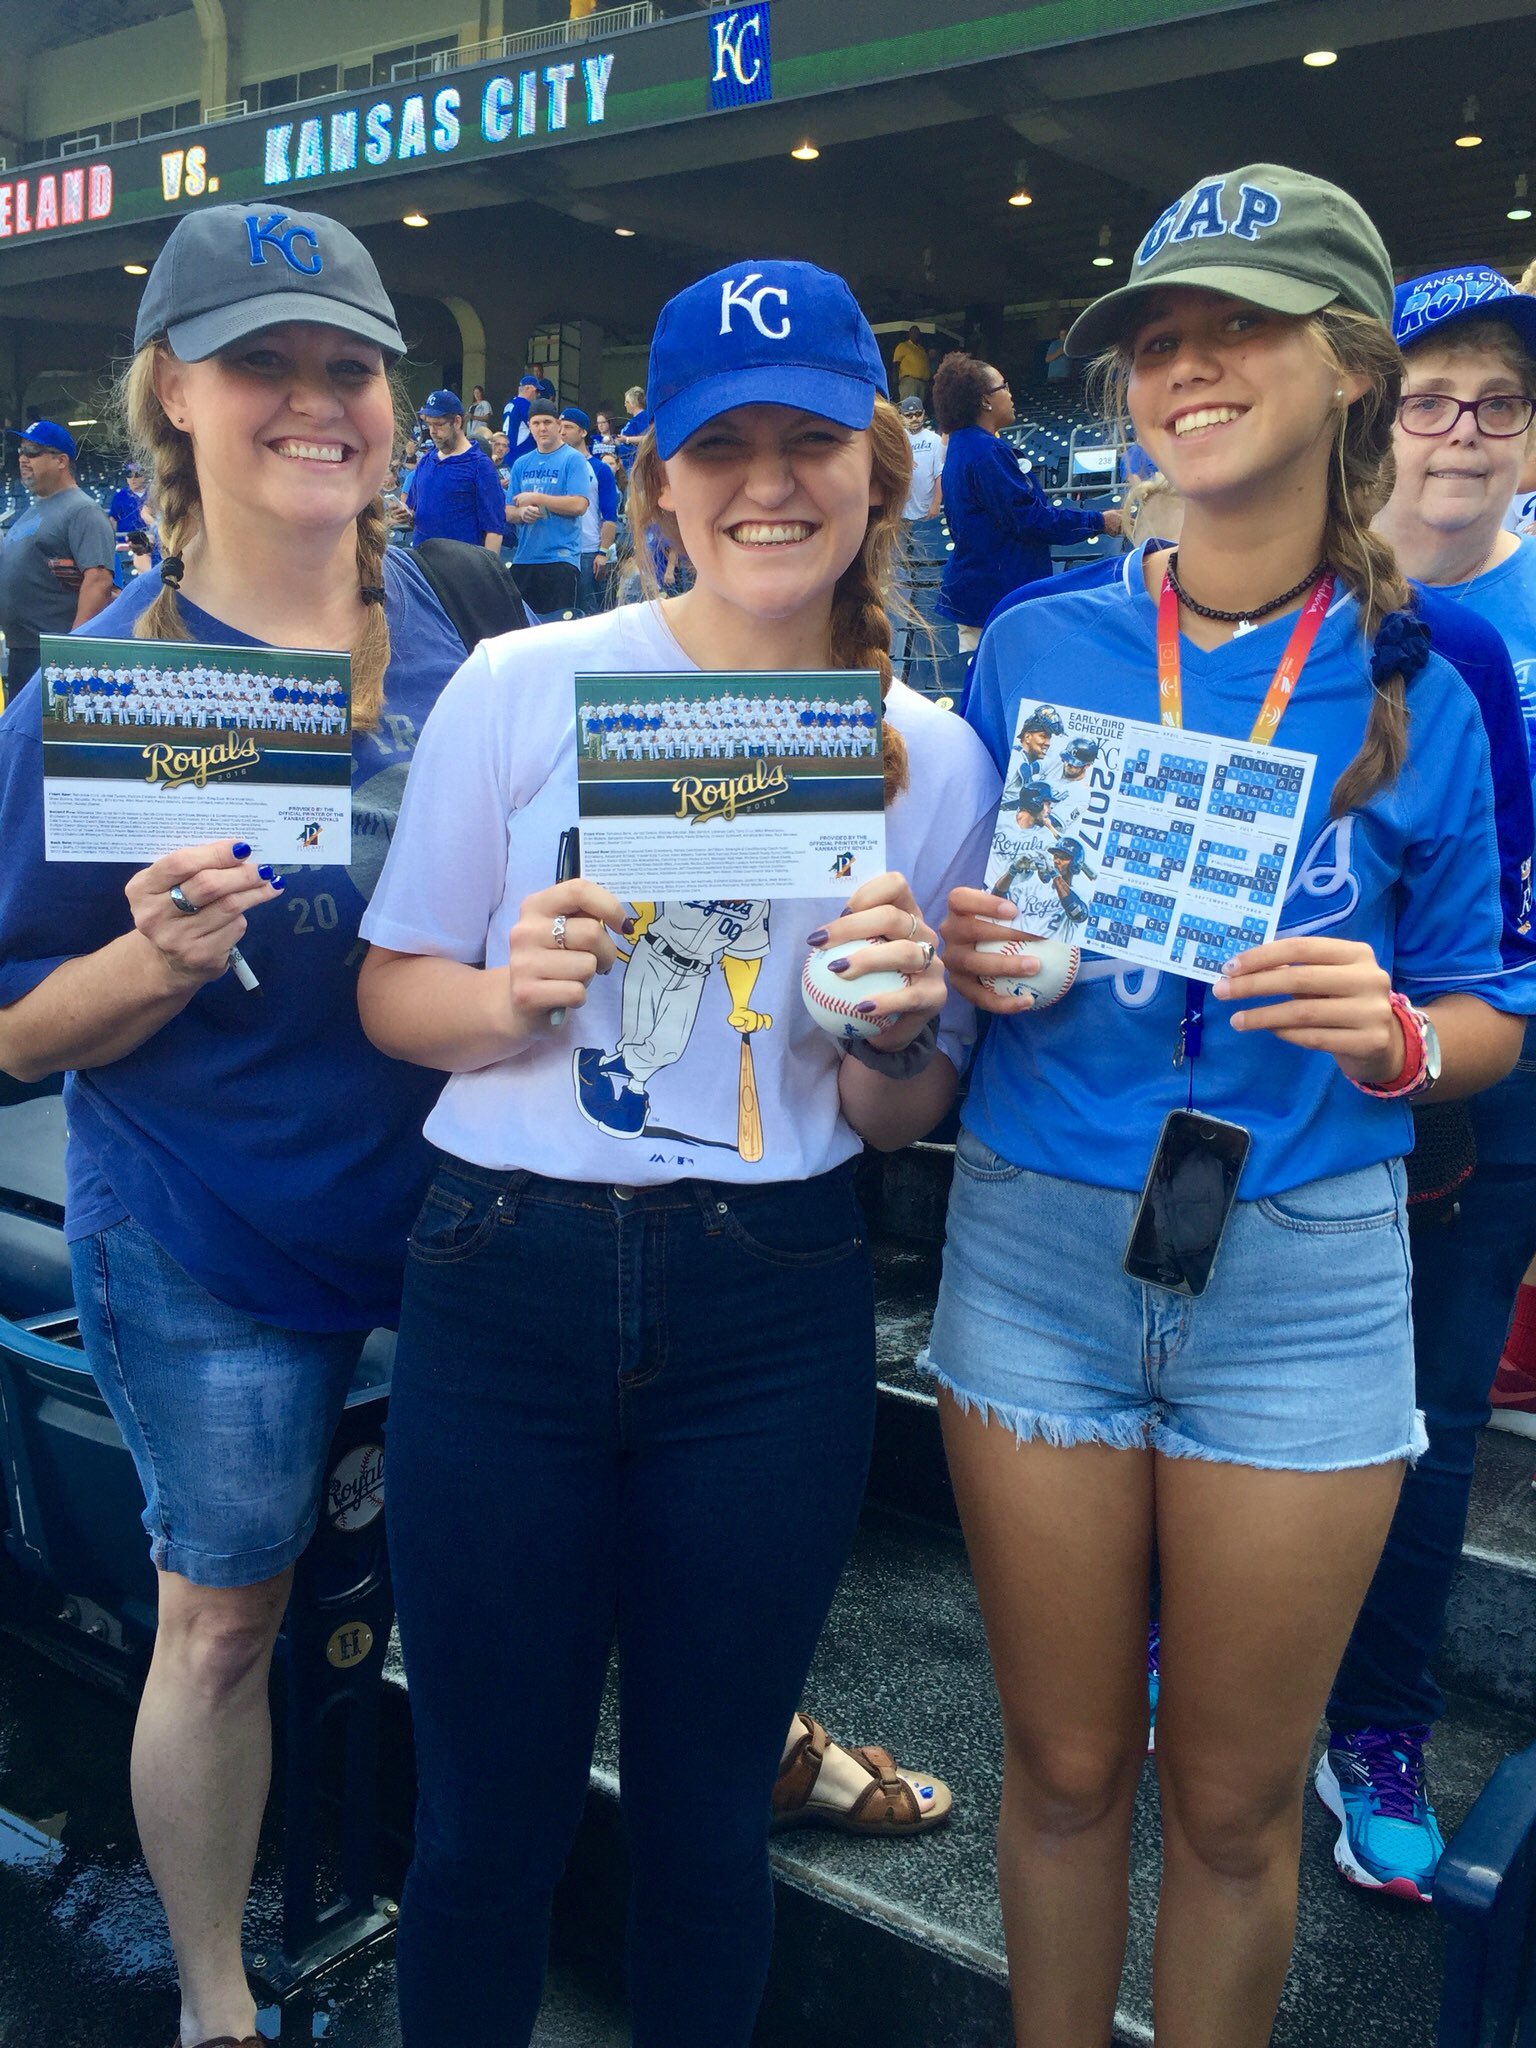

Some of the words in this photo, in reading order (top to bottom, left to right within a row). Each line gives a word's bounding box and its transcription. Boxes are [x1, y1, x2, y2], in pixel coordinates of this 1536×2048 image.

[712, 12, 760, 85] KC
[161, 145, 220, 201] VS.
[263, 87, 462, 186] KANSAS
[480, 53, 615, 145] CITY
[1137, 180, 1281, 266] GAP
[244, 213, 323, 276] KC
[1413, 272, 1474, 295] KANSAS
[719, 273, 791, 339] KC
[522, 469, 559, 480] ROYALS
[1068, 721, 1124, 740] SCHEDULE
[1070, 713, 1100, 724] EARLY
[1102, 719, 1125, 730] BIRD
[142, 730, 258, 789] Royals
[217, 768, 247, 780] 2016
[672, 759, 787, 823] Royals
[746, 798, 775, 812] 2016
[1079, 767, 1115, 851] 2017
[993, 831, 1043, 860] Royals
[1022, 895, 1060, 918] Roya
[718, 917, 743, 941] 00
[327, 1453, 385, 1513] Royal
[337, 1628, 361, 1662] H
